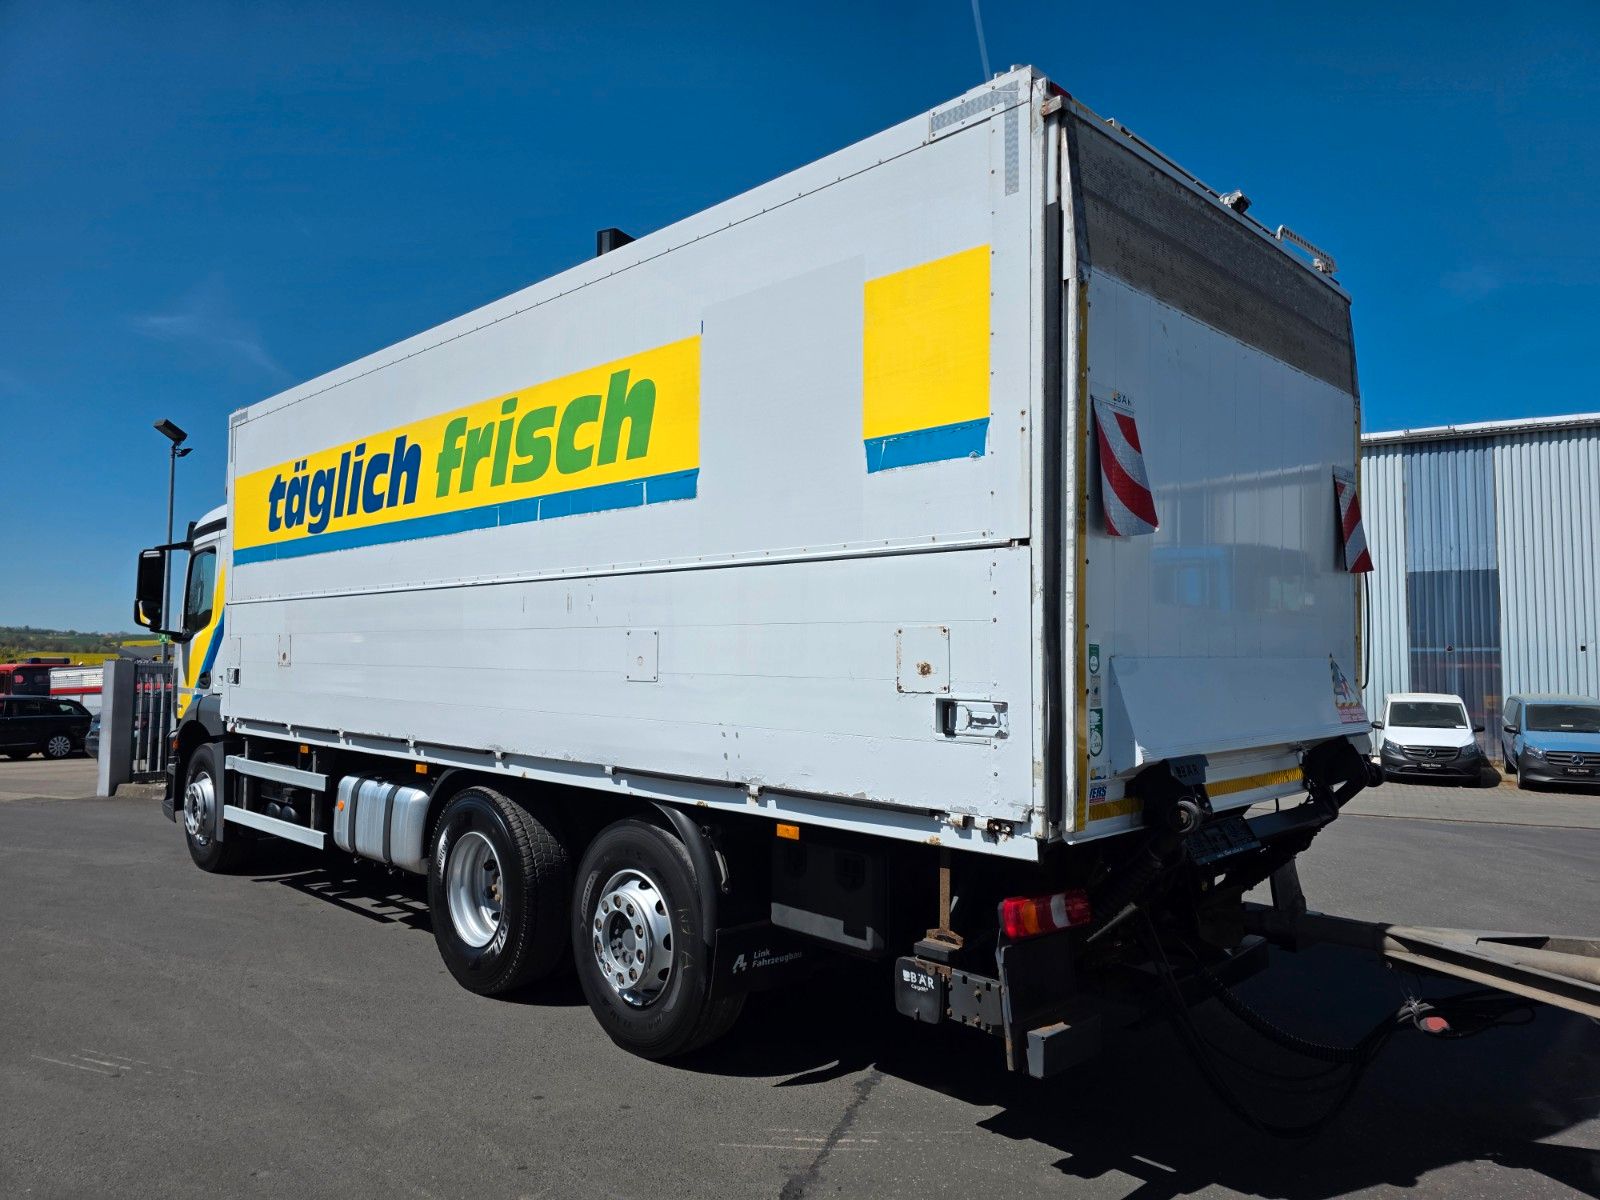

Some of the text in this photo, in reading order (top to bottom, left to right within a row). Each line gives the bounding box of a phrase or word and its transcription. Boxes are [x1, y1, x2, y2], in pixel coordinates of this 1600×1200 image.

[267, 368, 657, 534] täglich frisch
[752, 951, 803, 968] Fahrzeugbau
[753, 948, 770, 959] Link
[909, 970, 935, 990] BÄR
